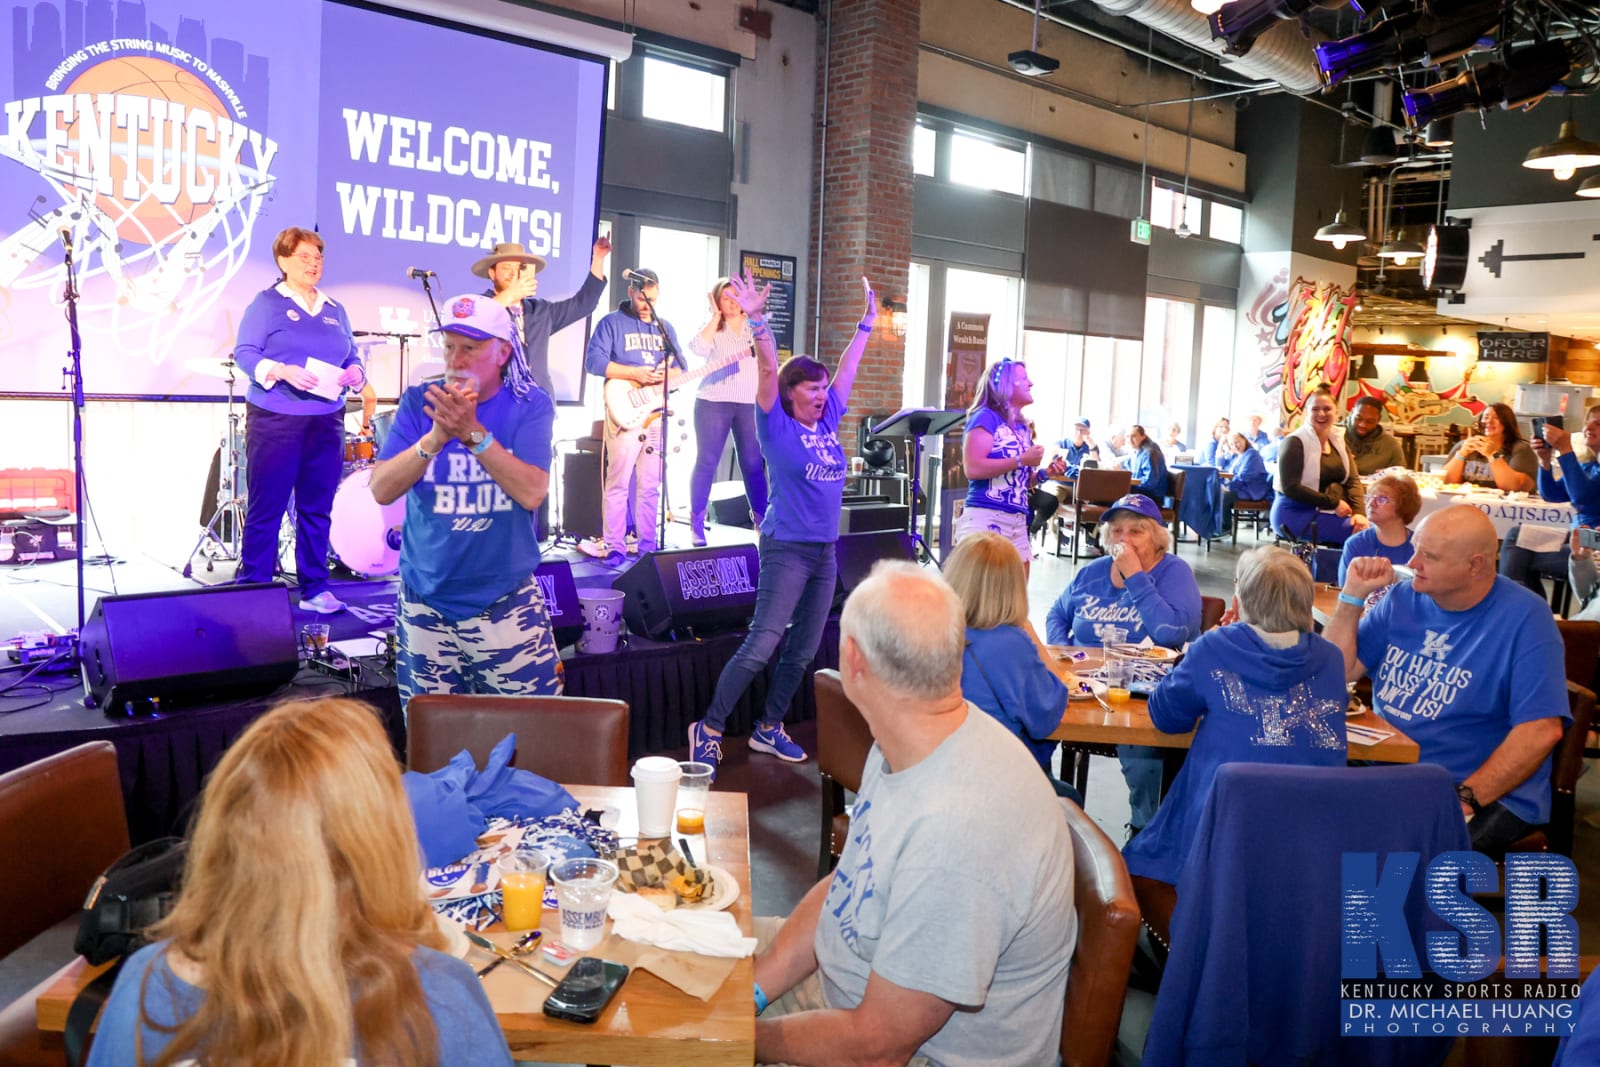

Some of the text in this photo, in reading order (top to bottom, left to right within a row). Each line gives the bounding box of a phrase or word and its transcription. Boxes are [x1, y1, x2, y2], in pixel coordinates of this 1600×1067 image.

[45, 38, 248, 119] BRINGING THE STRING MUSIC TO NASHVILLE
[4, 93, 278, 204] KENTUCKY
[342, 107, 560, 194] WELCOME,
[336, 181, 562, 258] WILDCATS!
[952, 334, 987, 345] Wealth Band
[960, 321, 985, 331] Common
[1479, 338, 1546, 349] ORDER
[1483, 349, 1540, 359] HERE
[433, 484, 513, 515] BLUE
[1494, 505, 1574, 524] versity
[677, 556, 750, 589] ASSEMBLY
[682, 582, 755, 600] FOOD HALL
[1075, 596, 1143, 632] Kentucky
[1387, 644, 1410, 668] OU
[1446, 666, 1472, 689] US
[1421, 678, 1457, 705] YOU
[1412, 697, 1443, 720] US!
